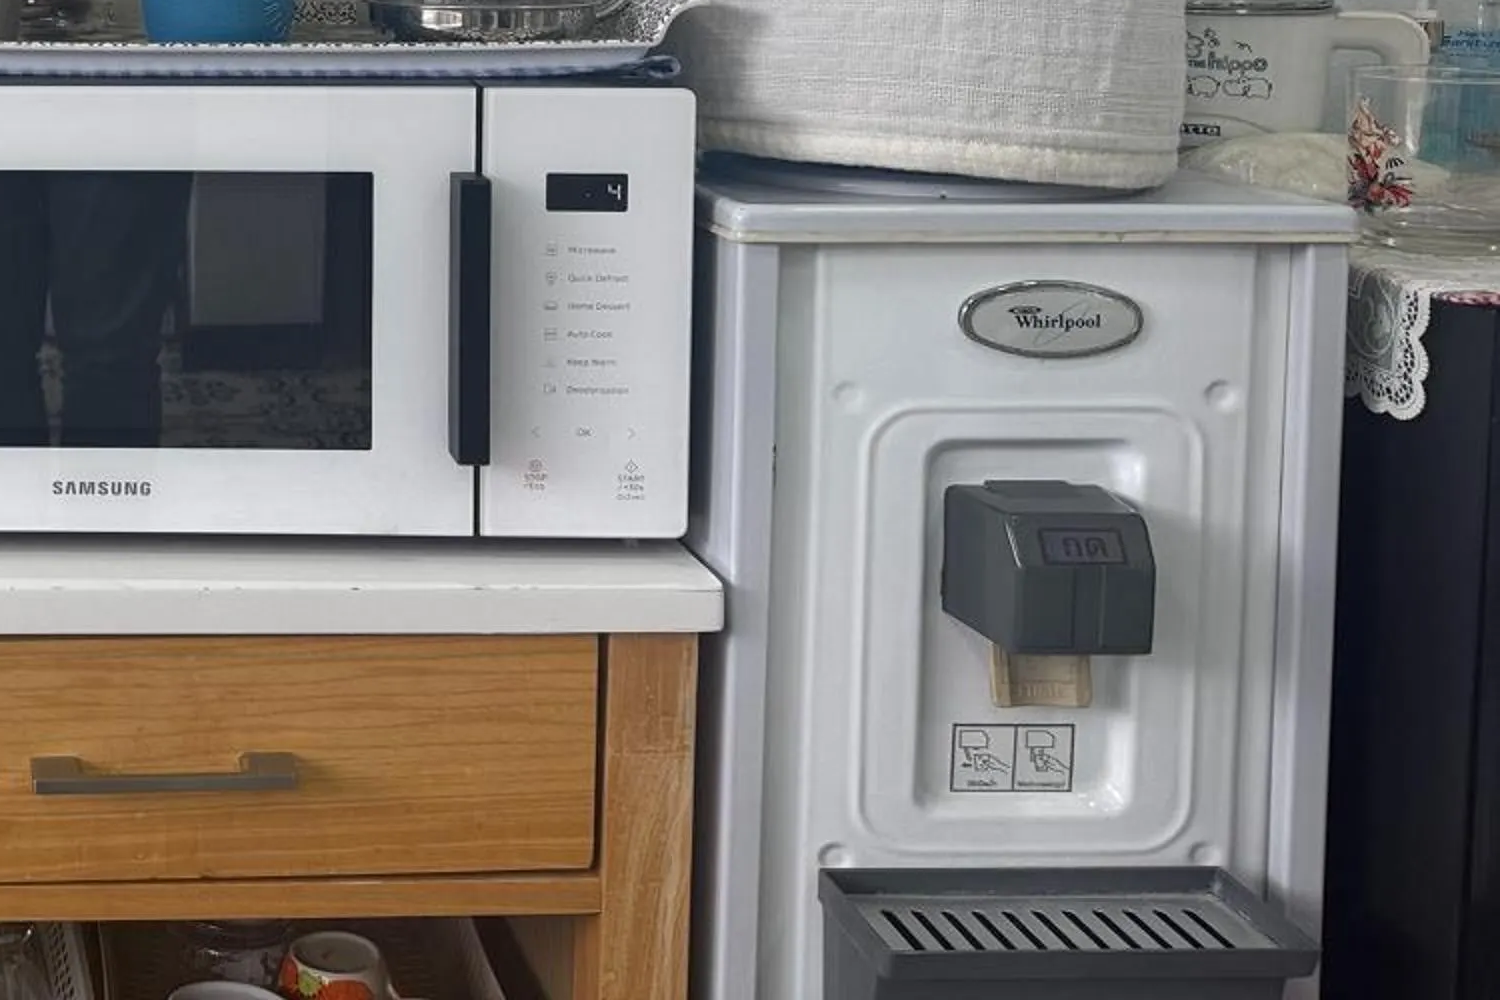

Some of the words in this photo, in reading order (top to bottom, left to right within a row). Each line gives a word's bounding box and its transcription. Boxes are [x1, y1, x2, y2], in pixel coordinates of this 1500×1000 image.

[1015, 313, 1102, 332] Whirlpool
[566, 330, 589, 339] Auto
[590, 330, 613, 339] Cook
[576, 427, 593, 437] OK
[51, 480, 152, 497] SAMSUNG
